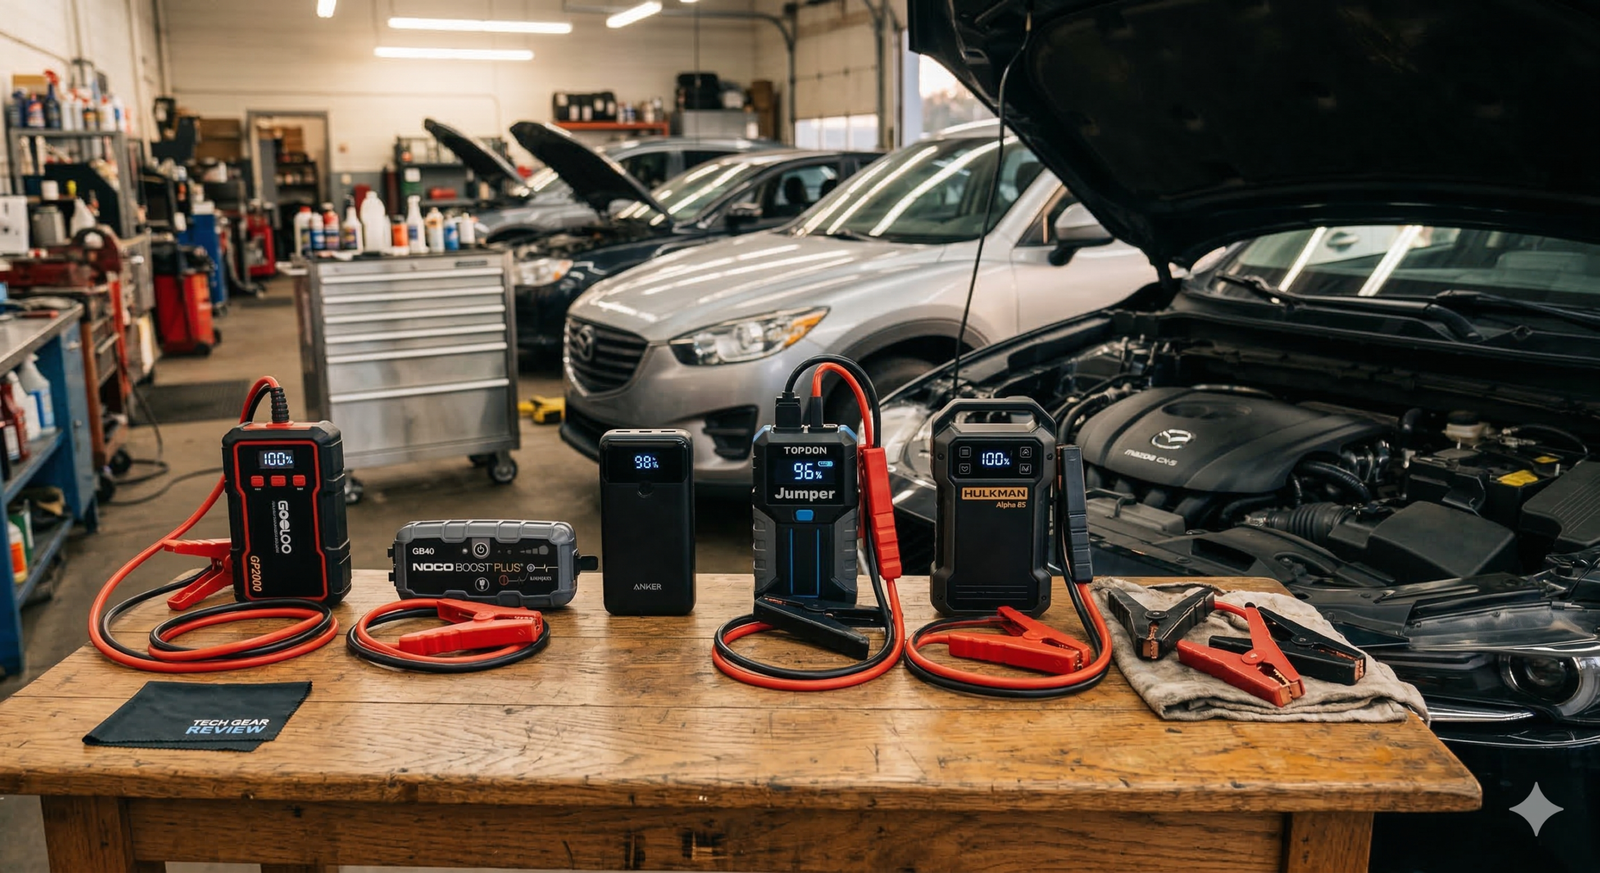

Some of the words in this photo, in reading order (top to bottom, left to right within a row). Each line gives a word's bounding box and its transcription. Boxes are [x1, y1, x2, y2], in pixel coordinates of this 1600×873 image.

[784, 446, 827, 454] TOPDON
[264, 452, 293, 466] 100%
[982, 452, 1010, 466] 100%
[794, 463, 822, 480] 96%
[775, 487, 835, 502] Jumper
[964, 489, 1026, 498] HULKMAN
[996, 501, 1016, 509] Alpha
[412, 547, 435, 555] GB40
[412, 563, 454, 571] NOCO
[494, 563, 521, 572] PLUS
[250, 555, 263, 592] GP2000
[633, 583, 662, 591] ANKER
[231, 718, 270, 726] GEAR
[185, 725, 266, 734] REVIEW
